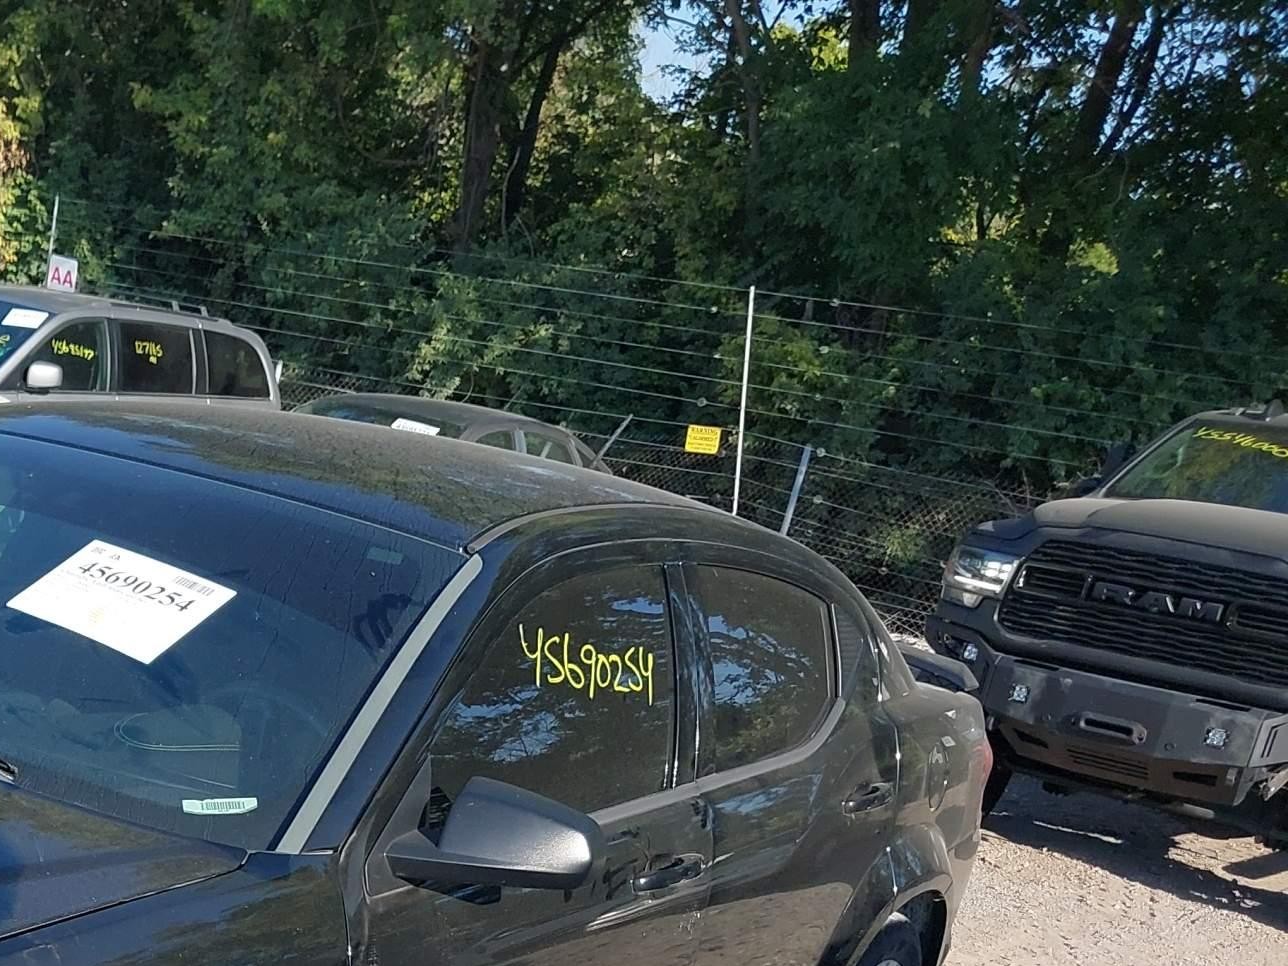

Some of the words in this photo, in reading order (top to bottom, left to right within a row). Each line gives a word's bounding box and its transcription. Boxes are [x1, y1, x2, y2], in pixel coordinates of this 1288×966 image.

[52, 267, 74, 289] AA
[78, 561, 196, 612] 45690254
[1091, 581, 1225, 622] RAM
[519, 623, 653, 706] 45690254
